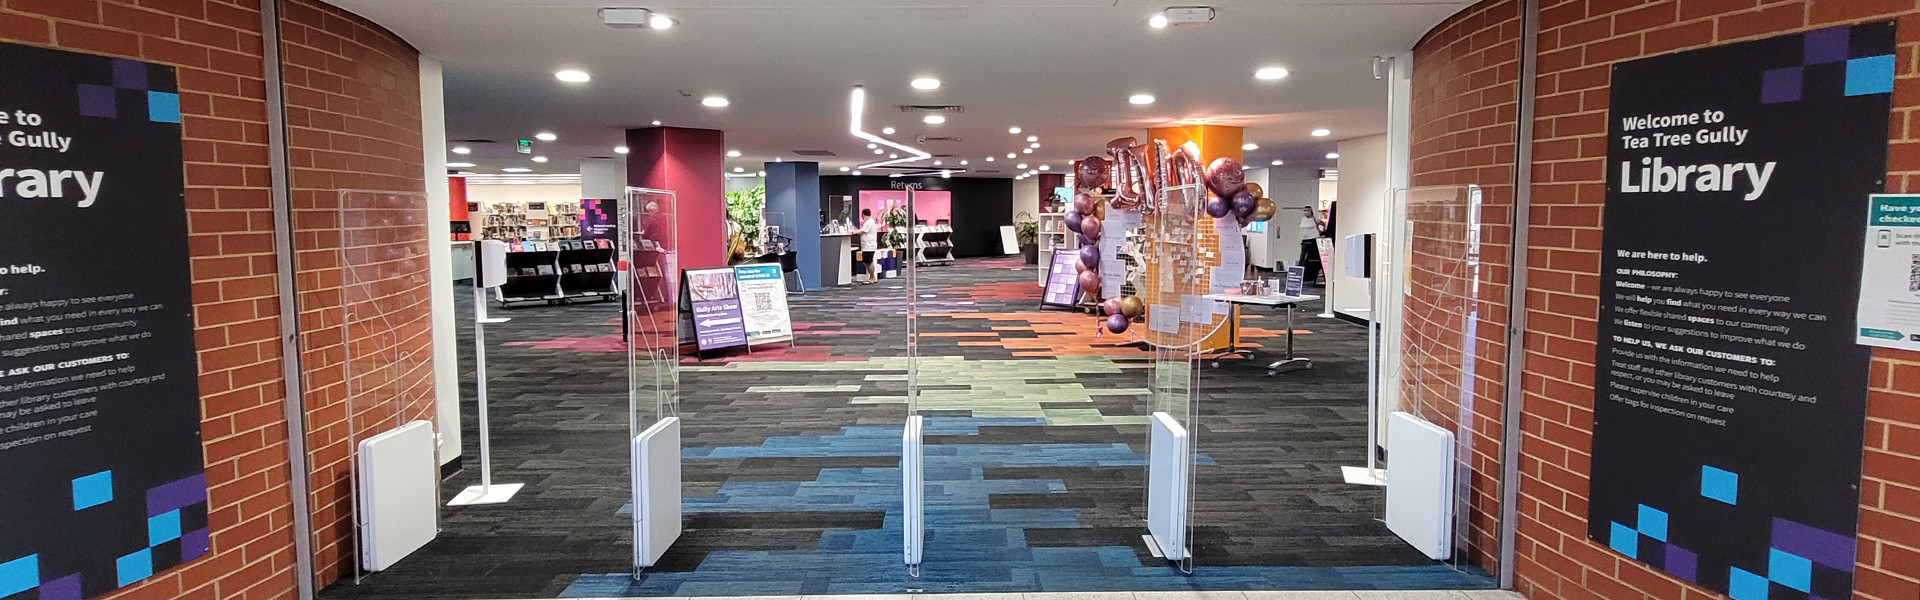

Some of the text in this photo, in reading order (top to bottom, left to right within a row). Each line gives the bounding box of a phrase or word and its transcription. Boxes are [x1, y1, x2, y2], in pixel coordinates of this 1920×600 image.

[15, 110, 42, 126] to
[1622, 109, 1725, 132] Welcome to
[8, 130, 72, 153] Gully
[1622, 126, 1749, 149] Tea Tree Gully
[1621, 157, 1777, 201] Library
[1880, 204, 1908, 212] Have
[1617, 249, 1708, 264] We are here to help.
[10, 264, 46, 275] help.
[1631, 269, 1678, 279] PHILOSOPHY:
[5, 293, 135, 311] always happy see everyone
[1615, 280, 1646, 290] Welcome
[1662, 285, 1673, 293] are
[1674, 286, 1698, 295] always
[1699, 287, 1723, 298] happy
[1734, 292, 1749, 300] see
[1749, 293, 1791, 303] everyone
[20, 314, 45, 325] what
[46, 314, 64, 323] you
[64, 310, 87, 320] need
[98, 308, 120, 316] every
[121, 307, 137, 315] way
[150, 303, 164, 311] can
[1636, 295, 1652, 304] help
[1666, 298, 1682, 307] find
[1683, 301, 1701, 309] what
[1701, 303, 1716, 311] you
[1717, 304, 1738, 313] need
[1748, 308, 1772, 318] every
[1773, 310, 1791, 320] way
[1792, 312, 1807, 320] we
[1808, 313, 1827, 322] can
[29, 319, 138, 339] spaces our community
[1624, 307, 1639, 315] offer
[1639, 308, 1662, 317] flexible
[1663, 312, 1687, 321] shared
[1687, 315, 1715, 324] spaces
[1740, 321, 1791, 335] community
[2, 343, 59, 357] suggestions
[60, 342, 70, 350] to
[71, 336, 107, 347] improve
[107, 334, 128, 343] what
[141, 331, 152, 339] do
[1623, 319, 1806, 350] listen your suggestions improve what we do
[1612, 335, 1777, 366] TO HELP US, WE ASK OUR CUSTOMERS TO:
[8, 352, 130, 376] ASK OUR CUSTOMERS TO:
[1612, 347, 1780, 383] Provide with the information we need to help
[14, 364, 136, 390] information we need help
[20, 373, 166, 405] library customers with courtesy and
[1610, 370, 1736, 400] respect, you may asked leave
[1611, 360, 1817, 404] Treat staff and other library customers with courtesy and
[19, 396, 98, 416] be asked to leave
[1610, 381, 1735, 414] Please supervise children your care
[5, 408, 99, 433] children in your care
[1609, 393, 1726, 427] Offer bags for inspection on request
[44, 432, 57, 441] on
[58, 424, 92, 438] request
